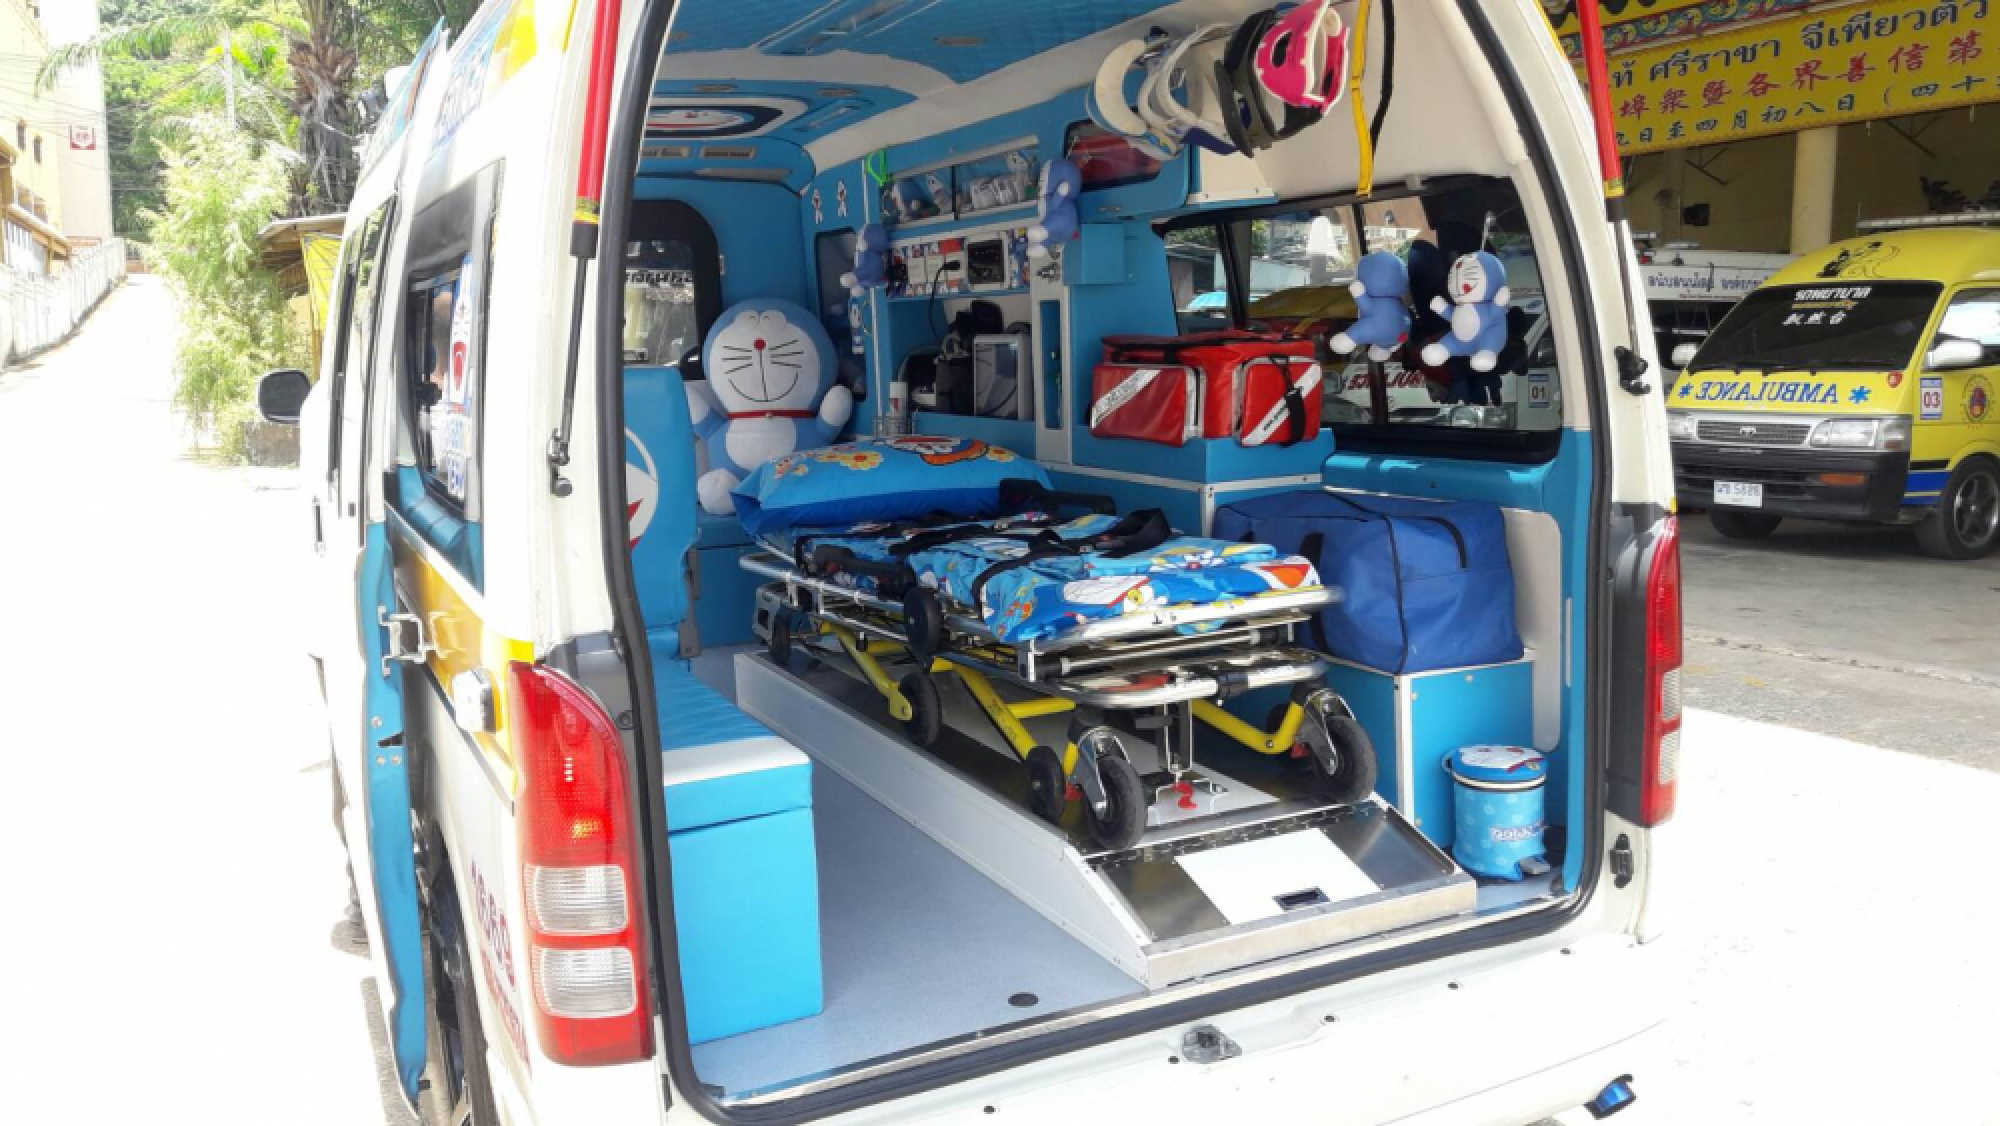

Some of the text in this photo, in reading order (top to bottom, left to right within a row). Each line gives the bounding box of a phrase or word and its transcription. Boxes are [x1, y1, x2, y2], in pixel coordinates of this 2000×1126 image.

[1649, 39, 1781, 82] ศรีราชา
[1531, 385, 1546, 400] 01
[1923, 391, 1941, 409] 03
